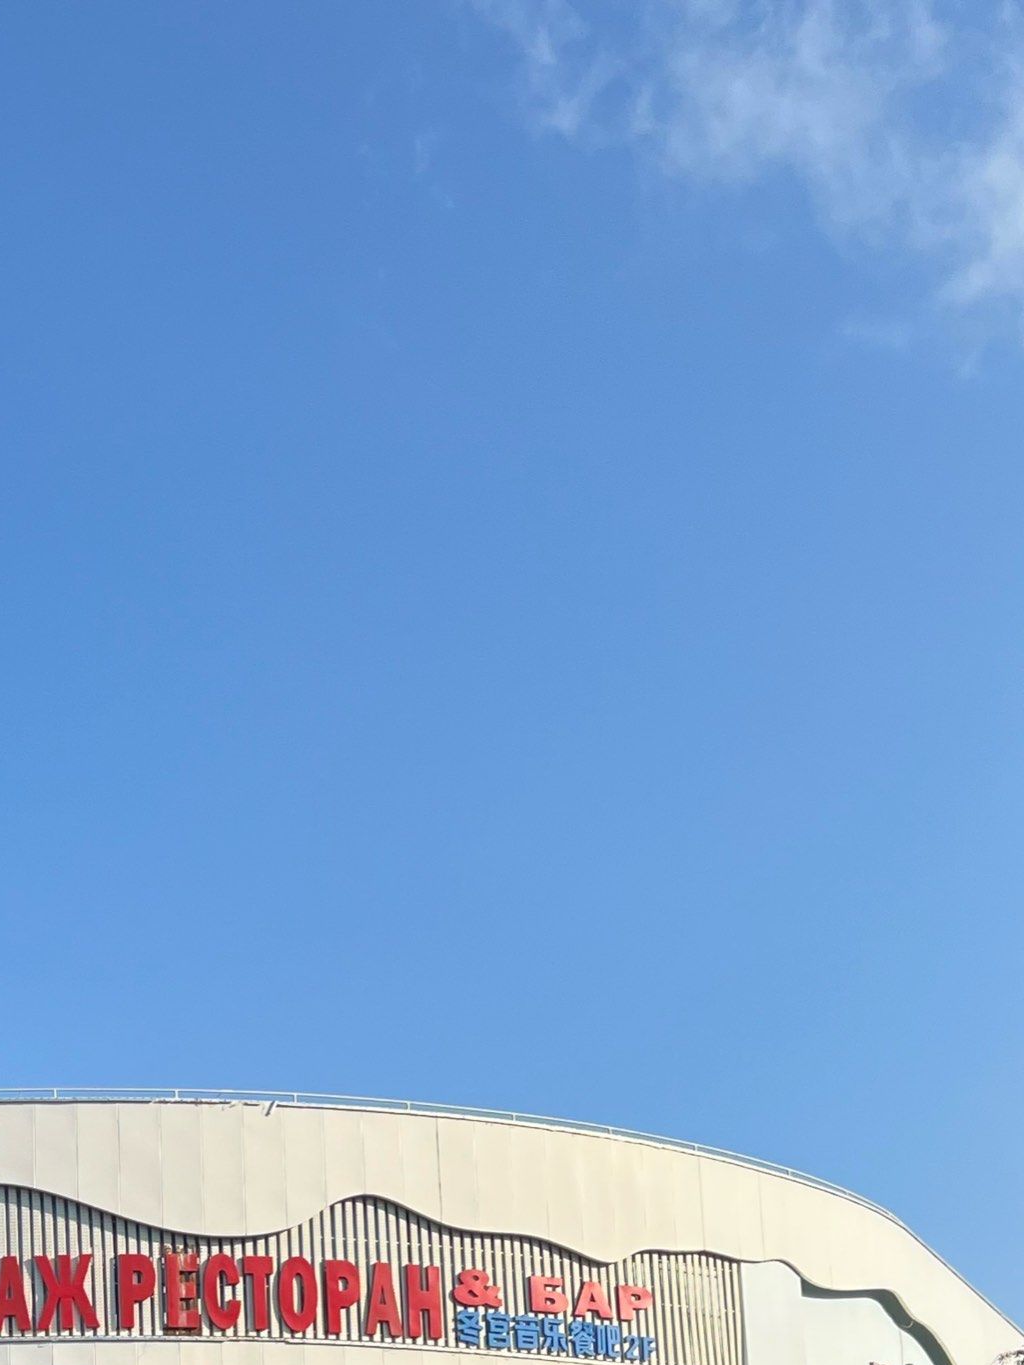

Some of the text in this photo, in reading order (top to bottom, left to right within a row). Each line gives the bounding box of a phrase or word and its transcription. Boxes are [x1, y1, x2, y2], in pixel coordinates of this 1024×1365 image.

[118, 1253, 442, 1339] РЕСТОРАН
[453, 1269, 503, 1308] &
[528, 1275, 653, 1321] БАР
